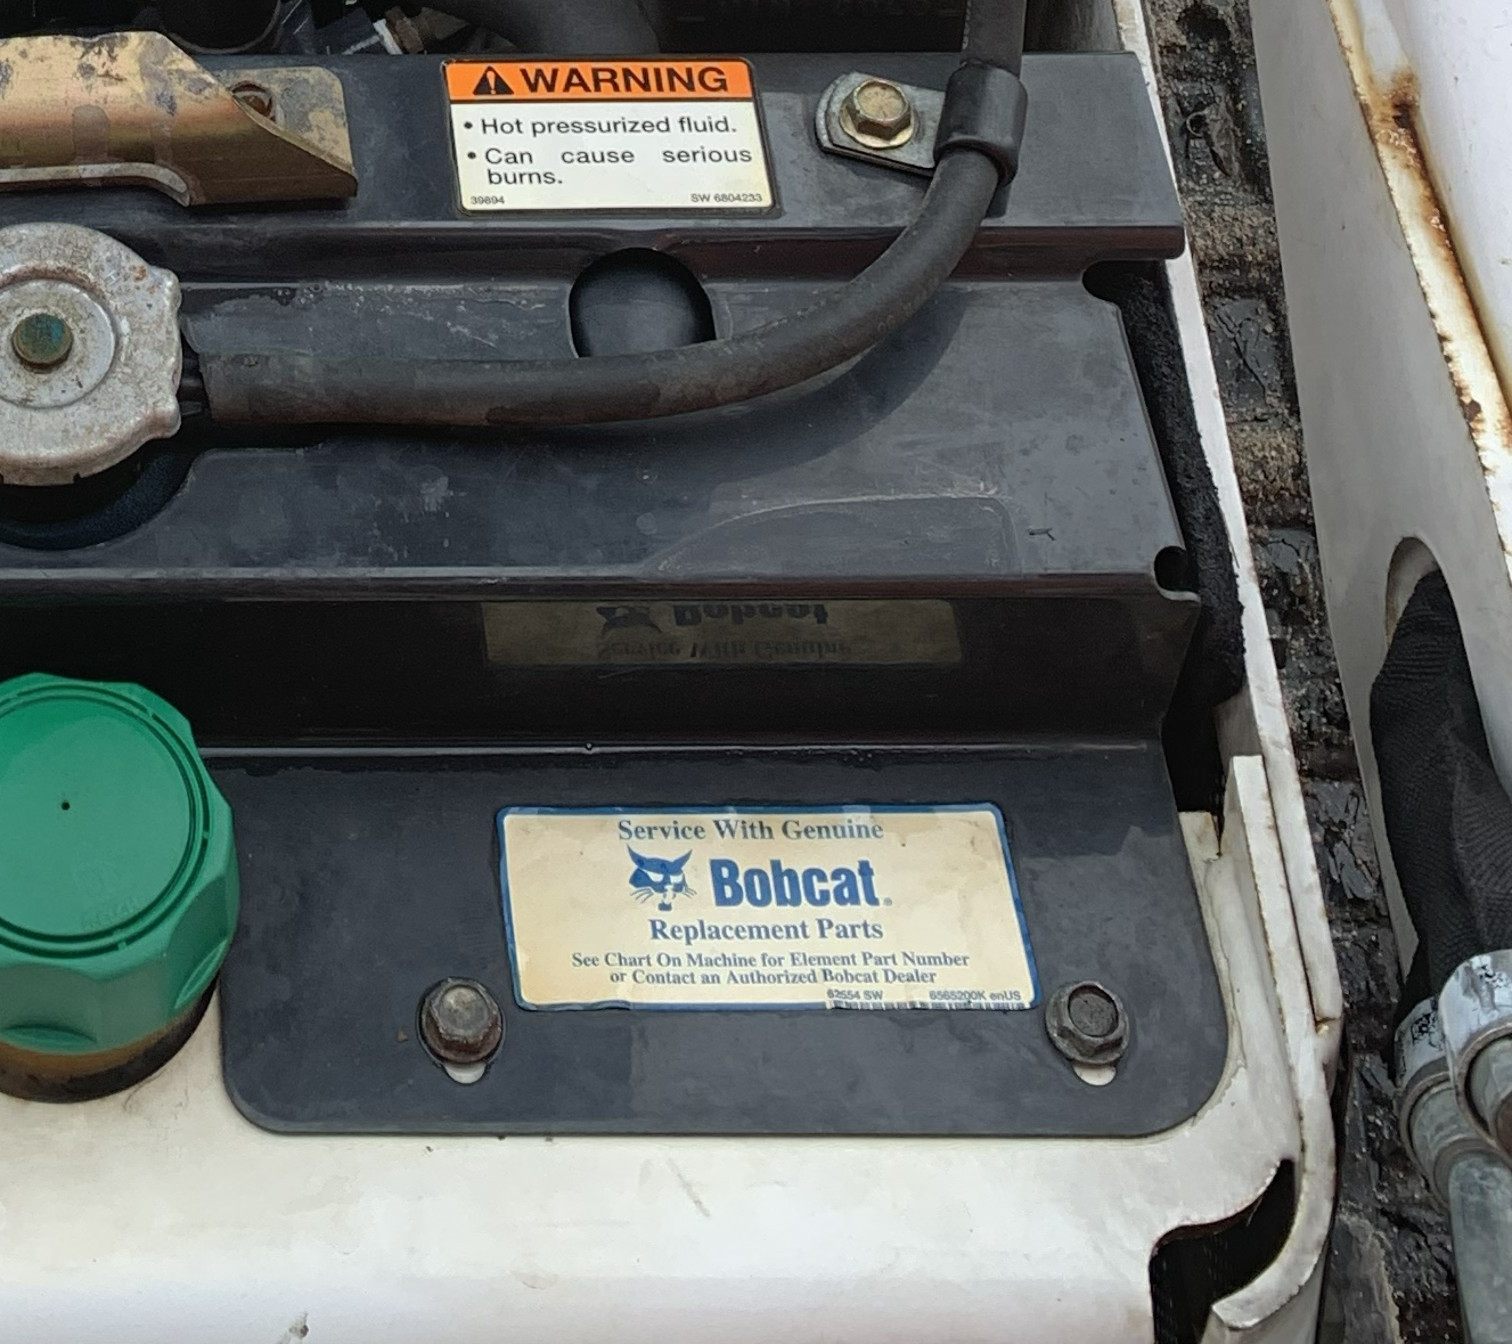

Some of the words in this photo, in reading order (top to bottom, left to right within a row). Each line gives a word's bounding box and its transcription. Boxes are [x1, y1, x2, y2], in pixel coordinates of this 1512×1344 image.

[520, 67, 728, 93] WARNING
[481, 118, 523, 135] Hot
[531, 116, 671, 138] pressurized
[678, 115, 737, 133] fluid.
[485, 147, 533, 165] Can
[561, 150, 635, 163] cause
[662, 145, 753, 163] serious
[488, 168, 563, 185] burns.
[691, 193, 710, 204] SW
[618, 820, 706, 840] Service
[713, 819, 775, 840] With
[782, 818, 884, 840] Genuine
[649, 918, 810, 945] Replacement
[816, 918, 884, 940] Parts
[572, 953, 600, 968] See
[605, 952, 652, 968] Chart
[657, 953, 682, 968] On
[686, 952, 756, 967] Machine
[761, 952, 786, 967] for
[790, 952, 857, 967] Element
[862, 952, 897, 967] Part
[902, 952, 969, 967] Number
[610, 972, 627, 984] or
[632, 969, 695, 984] Contact
[700, 972, 721, 983] an
[726, 969, 817, 984] Authorized
[822, 968, 879, 984] Bobcat
[884, 968, 938, 984] Dealer
[863, 990, 883, 1001] SW
[989, 990, 1022, 1000] enUS
